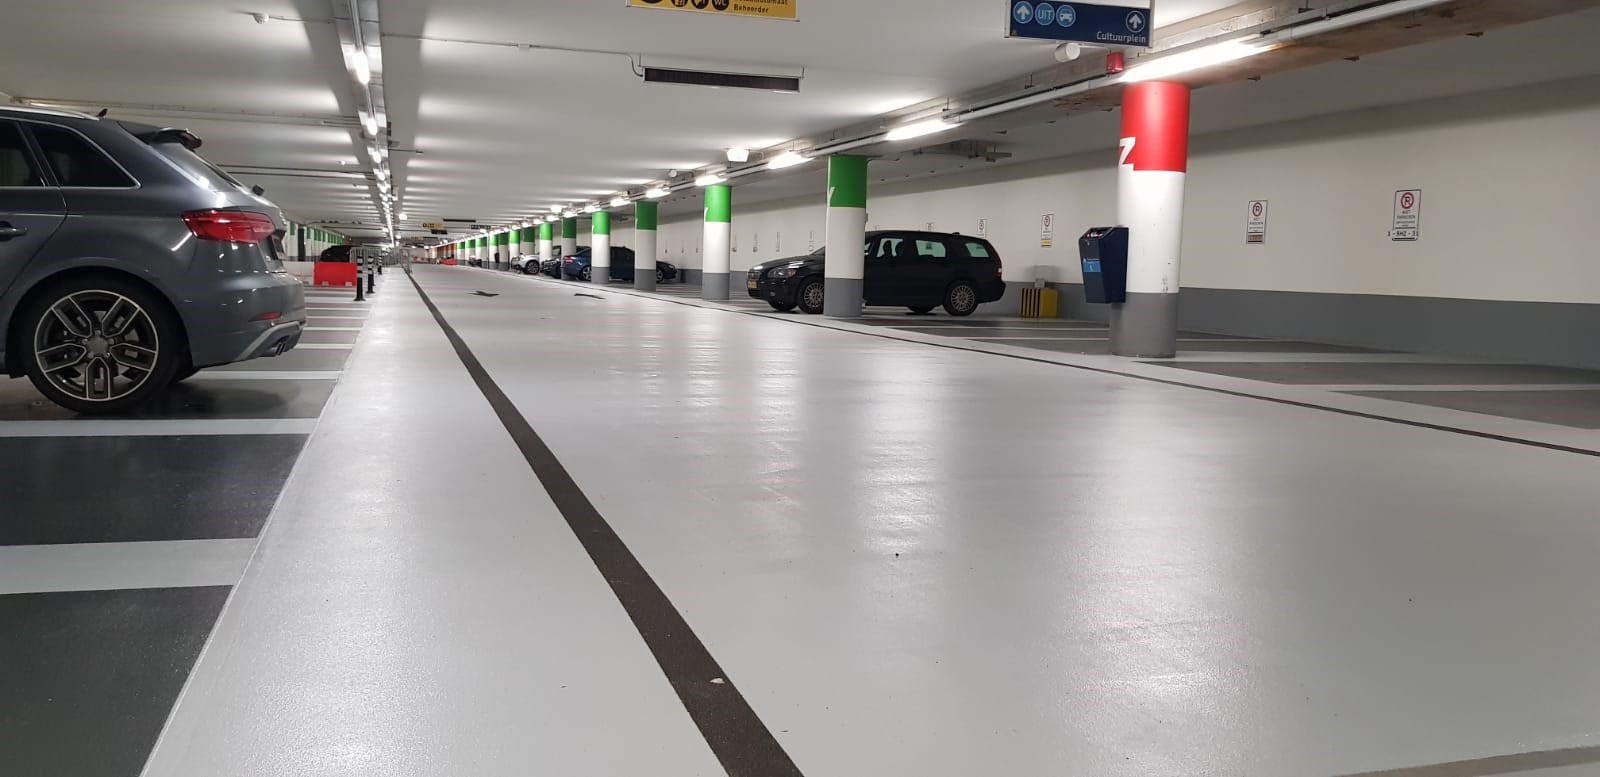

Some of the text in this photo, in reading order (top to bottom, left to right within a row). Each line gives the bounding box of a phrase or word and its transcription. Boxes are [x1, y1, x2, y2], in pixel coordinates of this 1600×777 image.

[734, 4, 769, 13] Beheerder
[1038, 9, 1053, 19] UIT
[1097, 31, 1146, 43] Cultuurplein
[1119, 137, 1136, 170] Z
